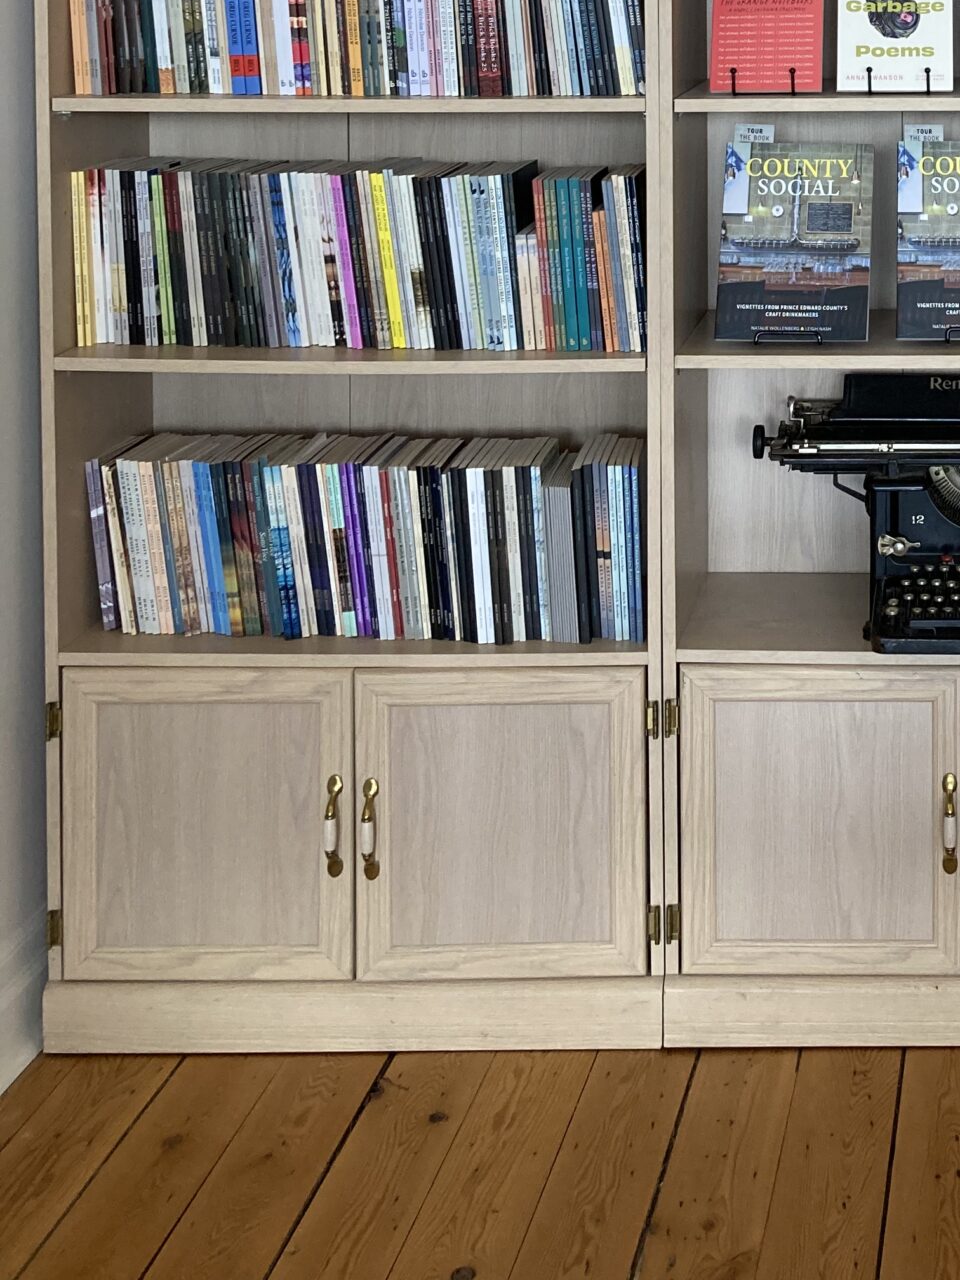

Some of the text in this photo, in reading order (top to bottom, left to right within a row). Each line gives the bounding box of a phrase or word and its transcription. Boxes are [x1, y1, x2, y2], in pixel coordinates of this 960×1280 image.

[846, 0, 945, 14] Garbage
[855, 45, 935, 58] Poems
[745, 158, 854, 177] COUNTY
[757, 178, 840, 196] SOCIAL
[911, 514, 925, 525] 12
